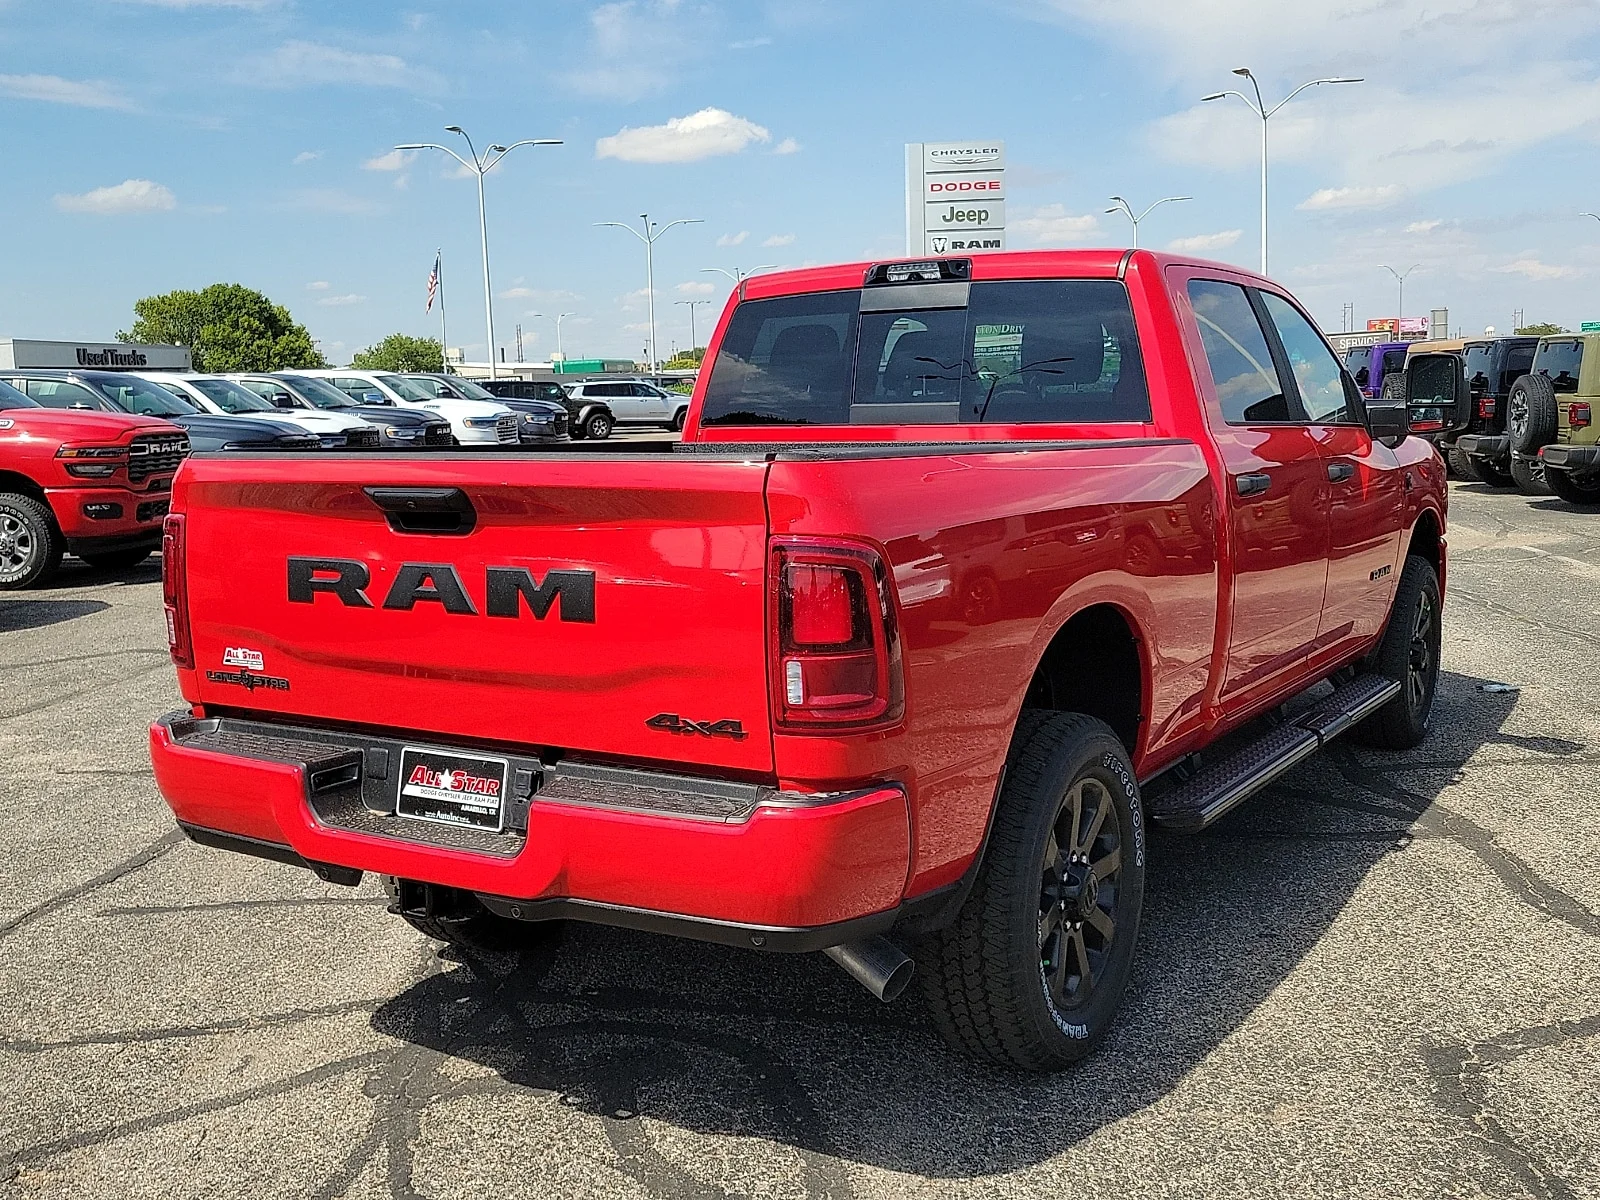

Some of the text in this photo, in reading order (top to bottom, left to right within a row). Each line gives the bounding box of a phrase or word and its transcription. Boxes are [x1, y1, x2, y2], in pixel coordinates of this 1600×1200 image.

[931, 148, 998, 156] CHRYSLER
[931, 181, 1000, 192] DODGE
[942, 206, 989, 225] Jeep
[952, 240, 1001, 249] RAM
[149, 442, 181, 453] RAM
[287, 554, 597, 624] RAM
[644, 712, 749, 742] 4x4
[408, 765, 500, 796] ALL STAR
